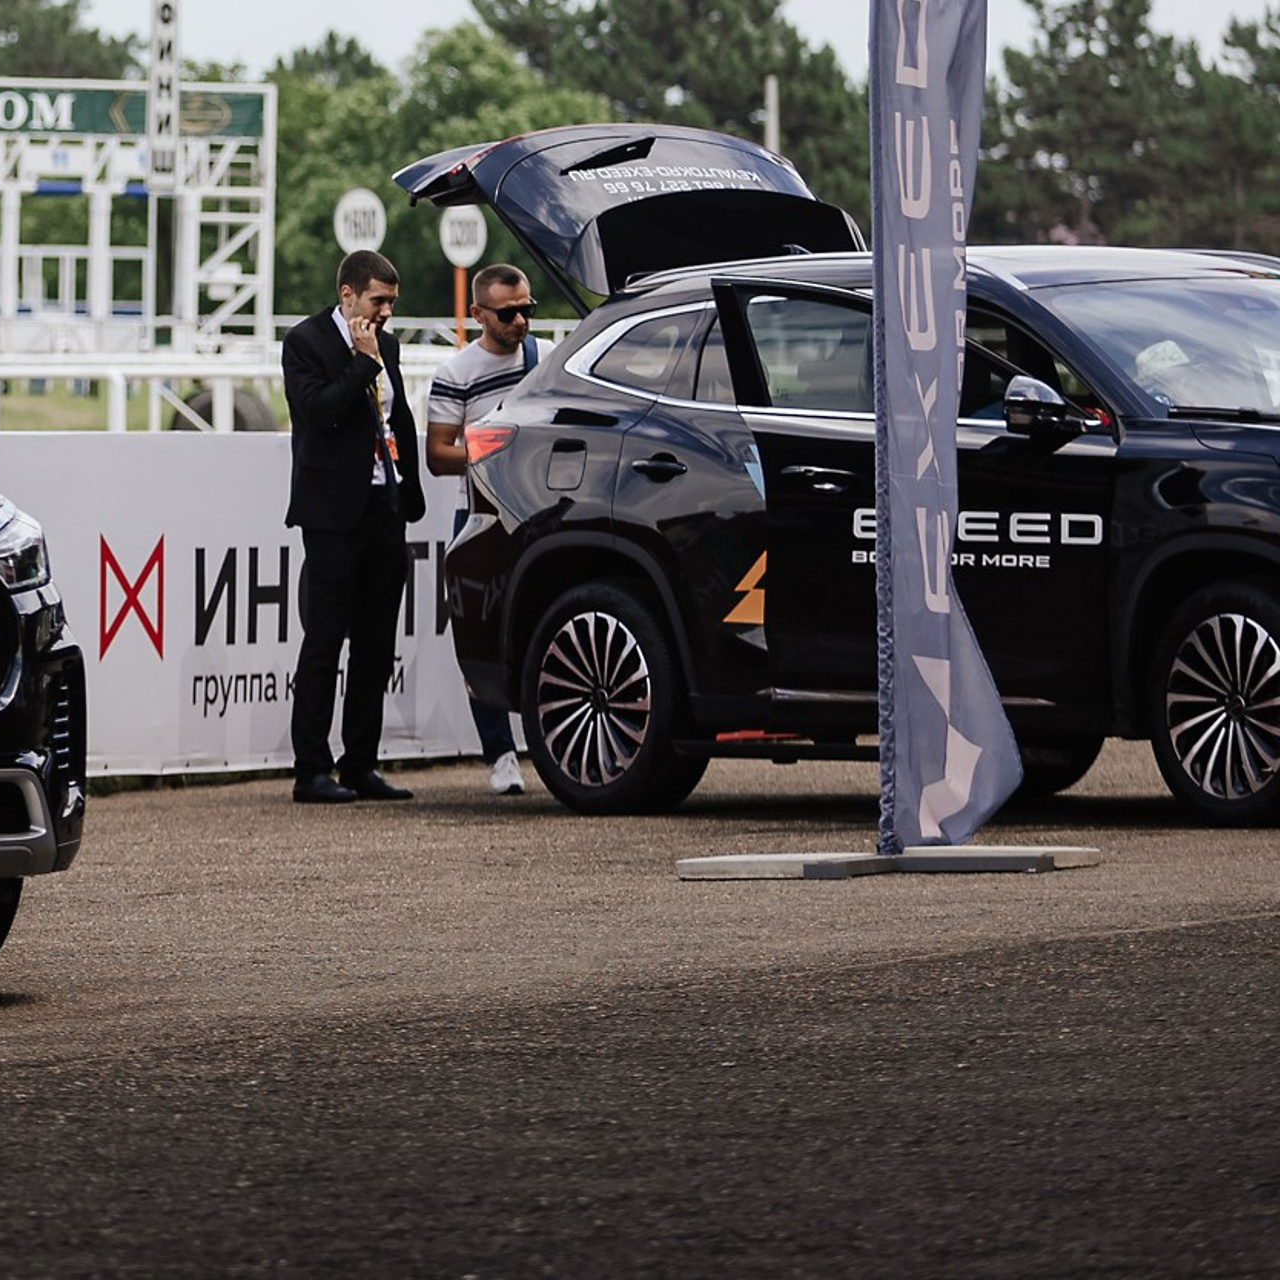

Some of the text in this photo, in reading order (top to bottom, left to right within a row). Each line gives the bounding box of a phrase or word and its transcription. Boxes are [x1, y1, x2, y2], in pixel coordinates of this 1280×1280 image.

[853, 507, 1104, 546] EEED
[982, 553, 1051, 568] MORE
[193, 671, 278, 718] группа
